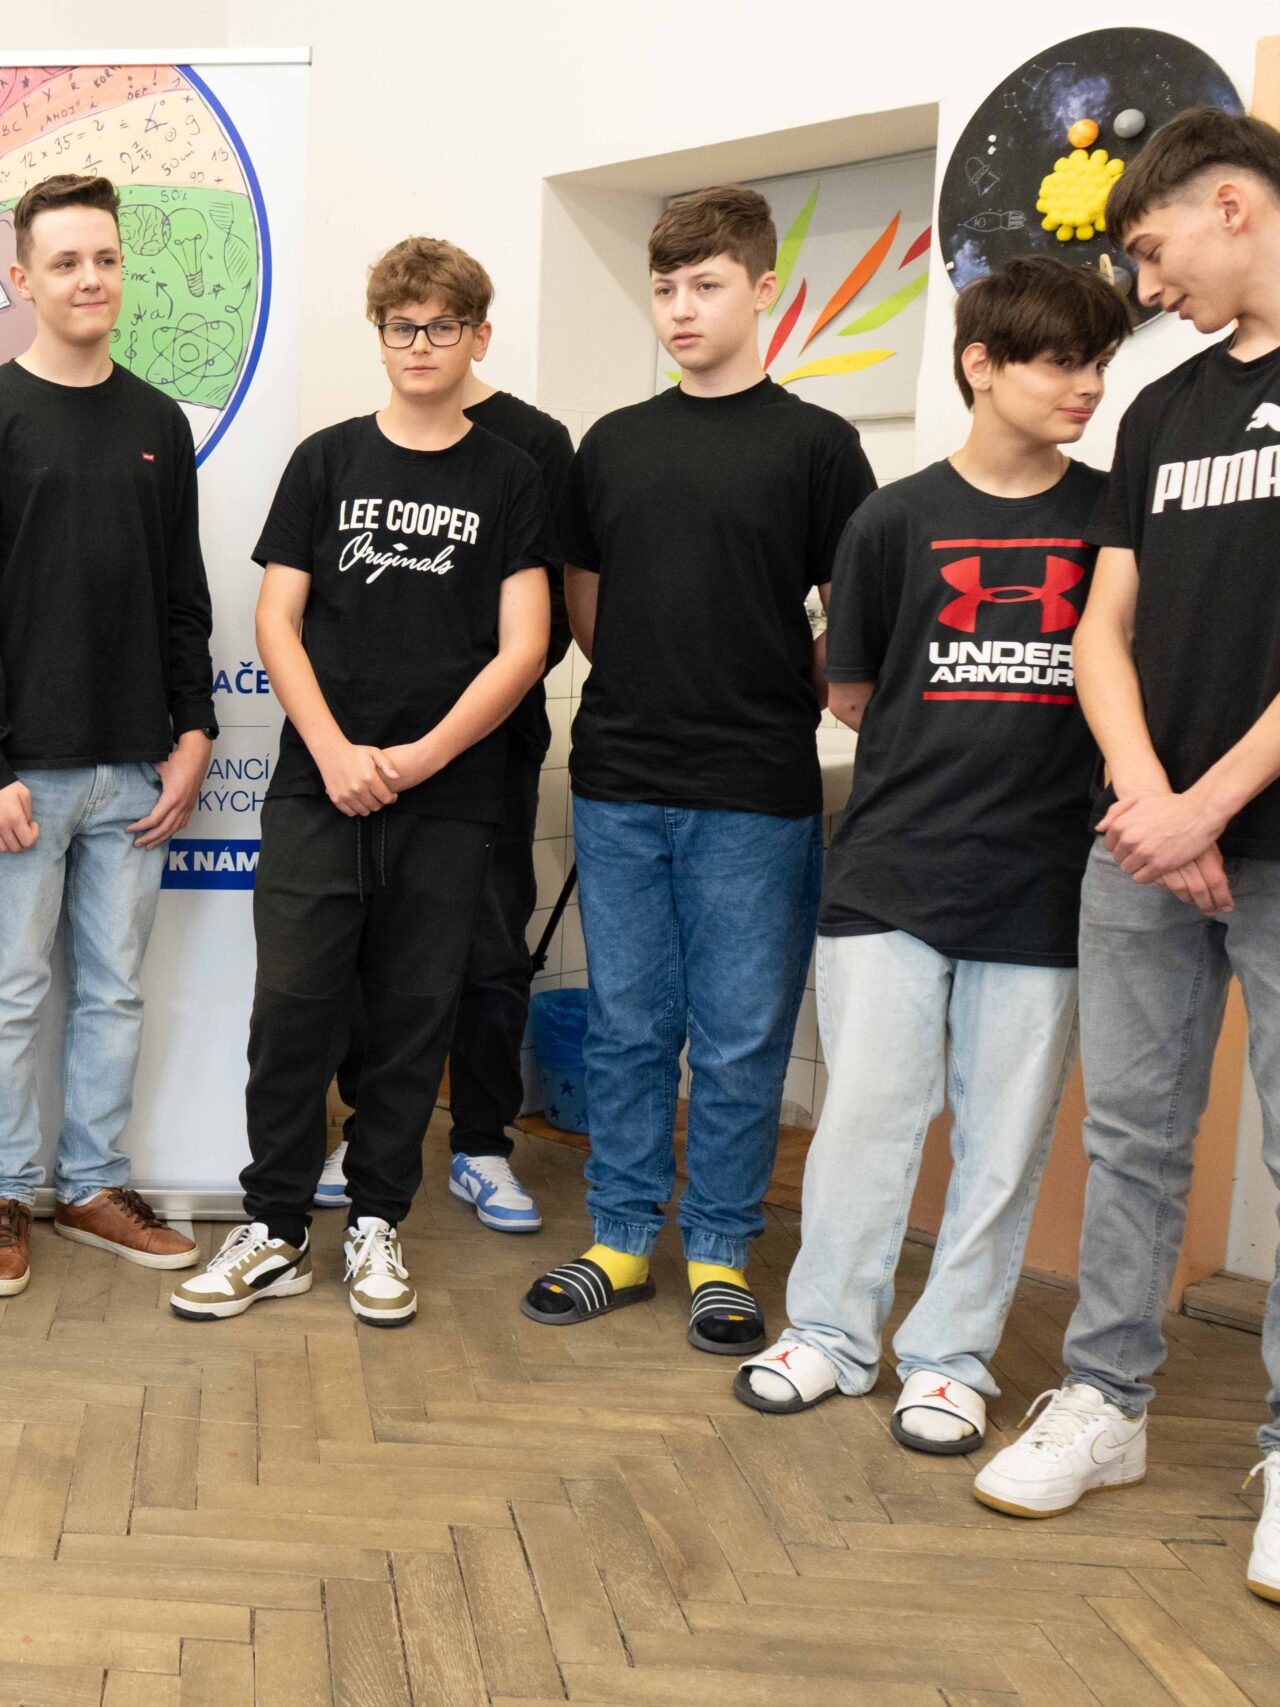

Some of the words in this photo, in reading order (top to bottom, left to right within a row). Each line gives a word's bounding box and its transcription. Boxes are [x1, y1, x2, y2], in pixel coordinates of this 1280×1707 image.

[1151, 444, 1280, 514] PUMA
[338, 498, 383, 532] LEE
[386, 499, 480, 545] COOPER
[339, 531, 456, 584] Originals
[928, 640, 1073, 668] UNDER
[211, 661, 270, 694] AČE
[929, 665, 1074, 687] ARMOUR
[206, 752, 270, 780] ANCÍ
[198, 785, 265, 812] KÝCH
[169, 851, 189, 872] K
